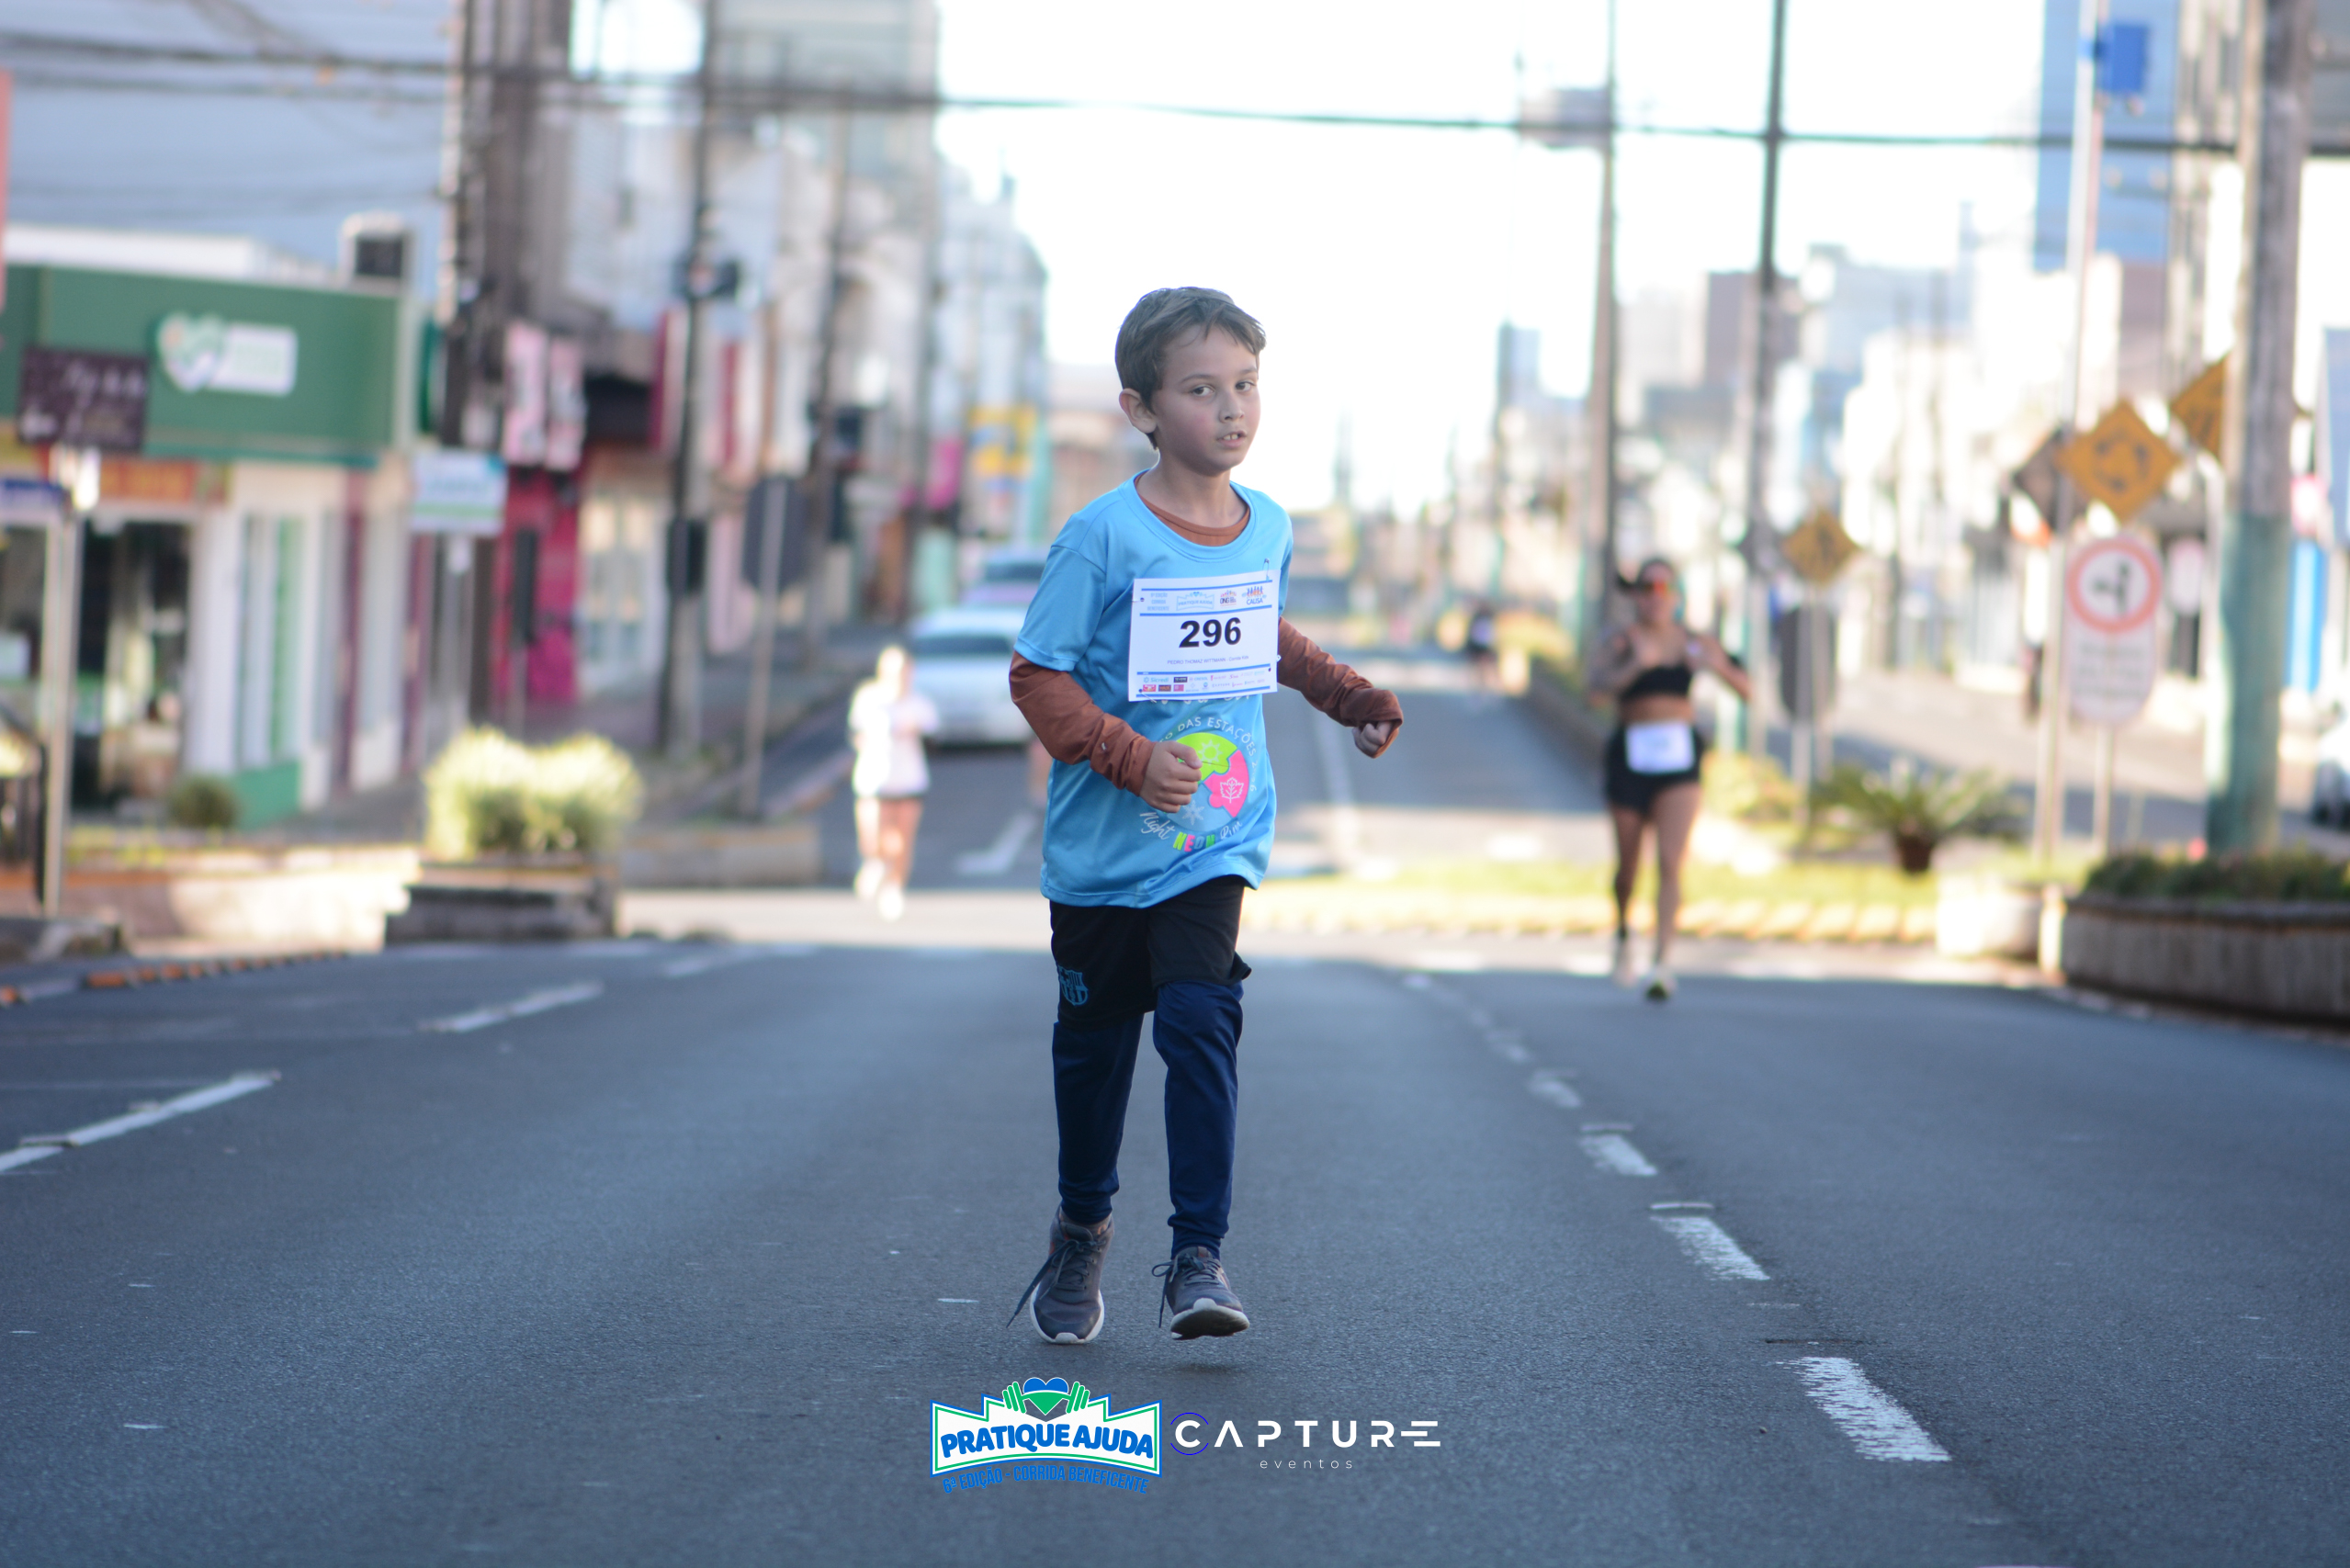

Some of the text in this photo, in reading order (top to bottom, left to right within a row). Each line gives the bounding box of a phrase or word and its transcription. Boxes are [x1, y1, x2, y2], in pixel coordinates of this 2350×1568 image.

[1179, 617, 1242, 648] 296
[1178, 716, 1202, 732] DAS
[1207, 716, 1257, 757] ESTAÇÕES
[1139, 812, 1175, 840] Night
[1173, 831, 1215, 852] NEON
